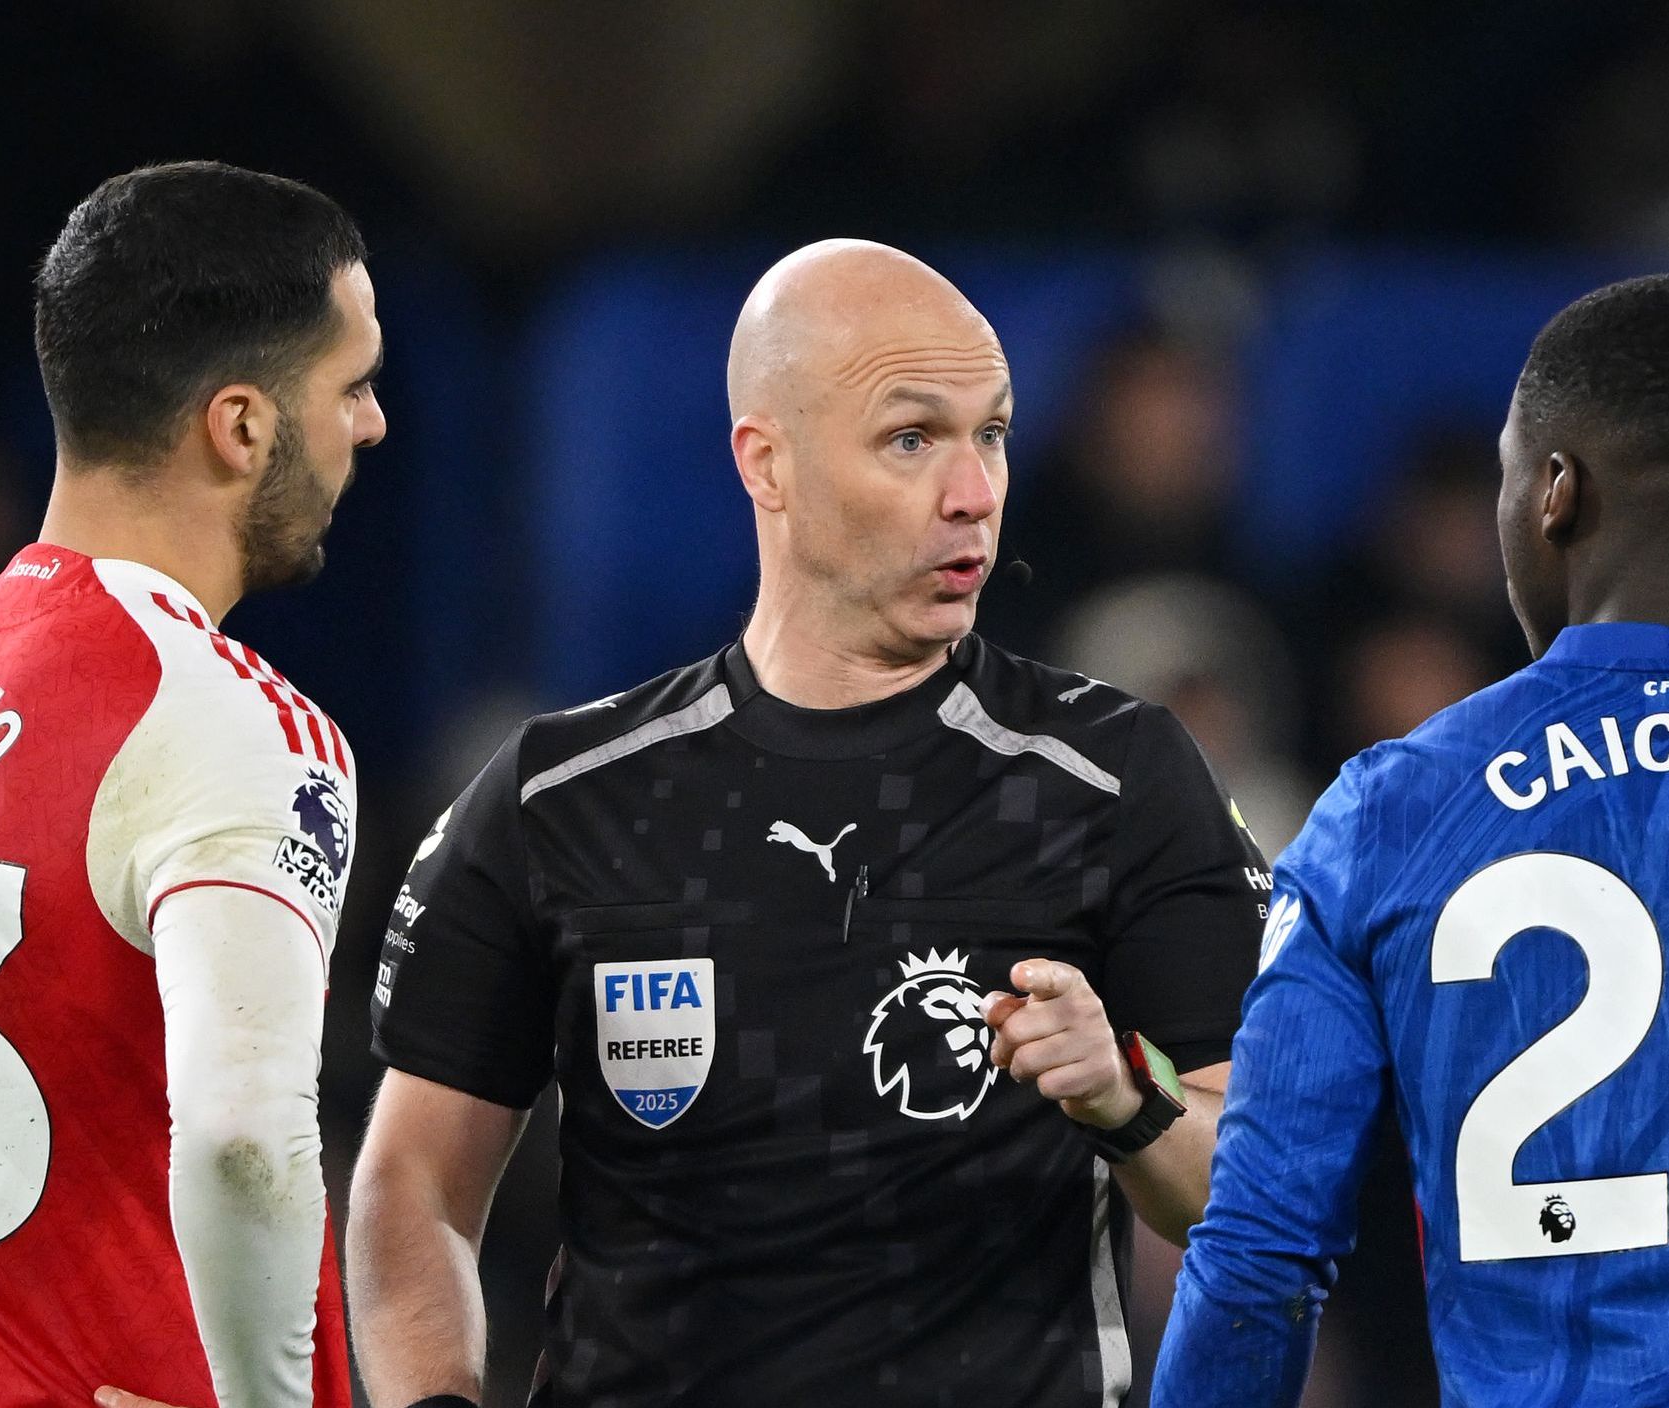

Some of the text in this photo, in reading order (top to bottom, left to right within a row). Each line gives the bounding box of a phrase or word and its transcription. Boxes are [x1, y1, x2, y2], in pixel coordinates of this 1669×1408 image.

[394, 884, 426, 927] Gray
[605, 972, 702, 1012] FIFA
[607, 1037, 703, 1061] REFEREE
[635, 1093, 678, 1112] 2025
